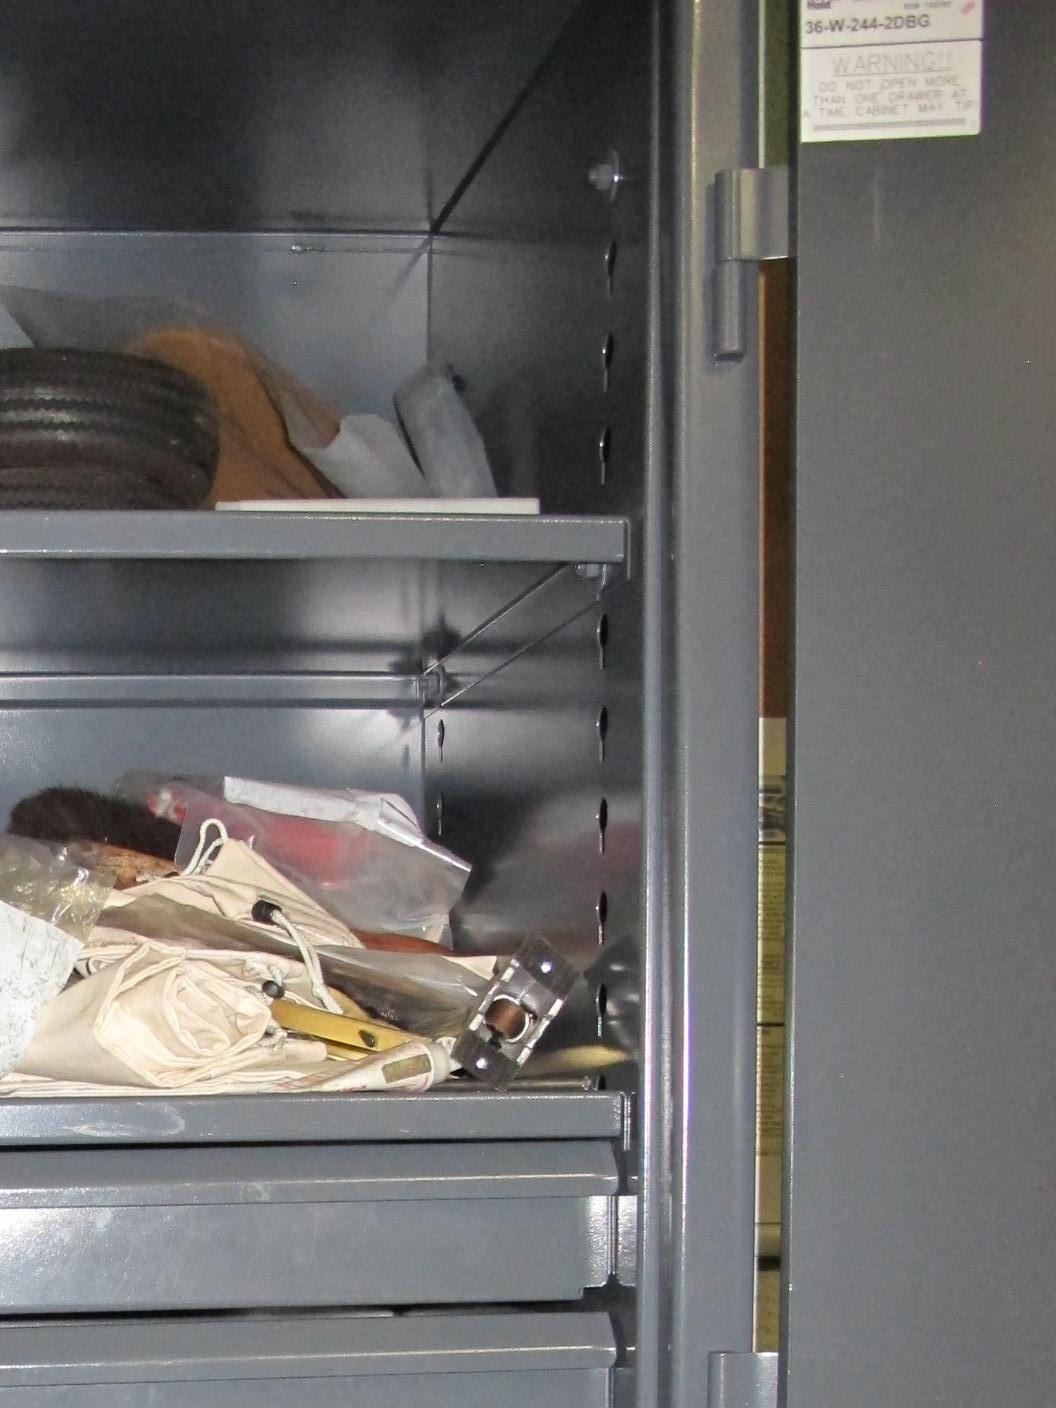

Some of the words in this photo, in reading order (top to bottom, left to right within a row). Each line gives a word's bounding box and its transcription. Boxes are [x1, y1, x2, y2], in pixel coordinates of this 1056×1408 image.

[805, 15, 930, 34] 36-W-244-2DBG
[818, 81, 837, 93] DO
[846, 79, 871, 91] NOT
[880, 77, 917, 90] OPEN
[925, 74, 961, 86] MORE
[813, 95, 846, 106] THAN
[854, 92, 880, 104] ONE
[888, 90, 944, 102] DRAWER
[951, 88, 968, 98] AT
[802, 109, 810, 119] A
[819, 106, 849, 118] TIME
[855, 103, 908, 116] CABINET
[918, 101, 944, 113] MAY
